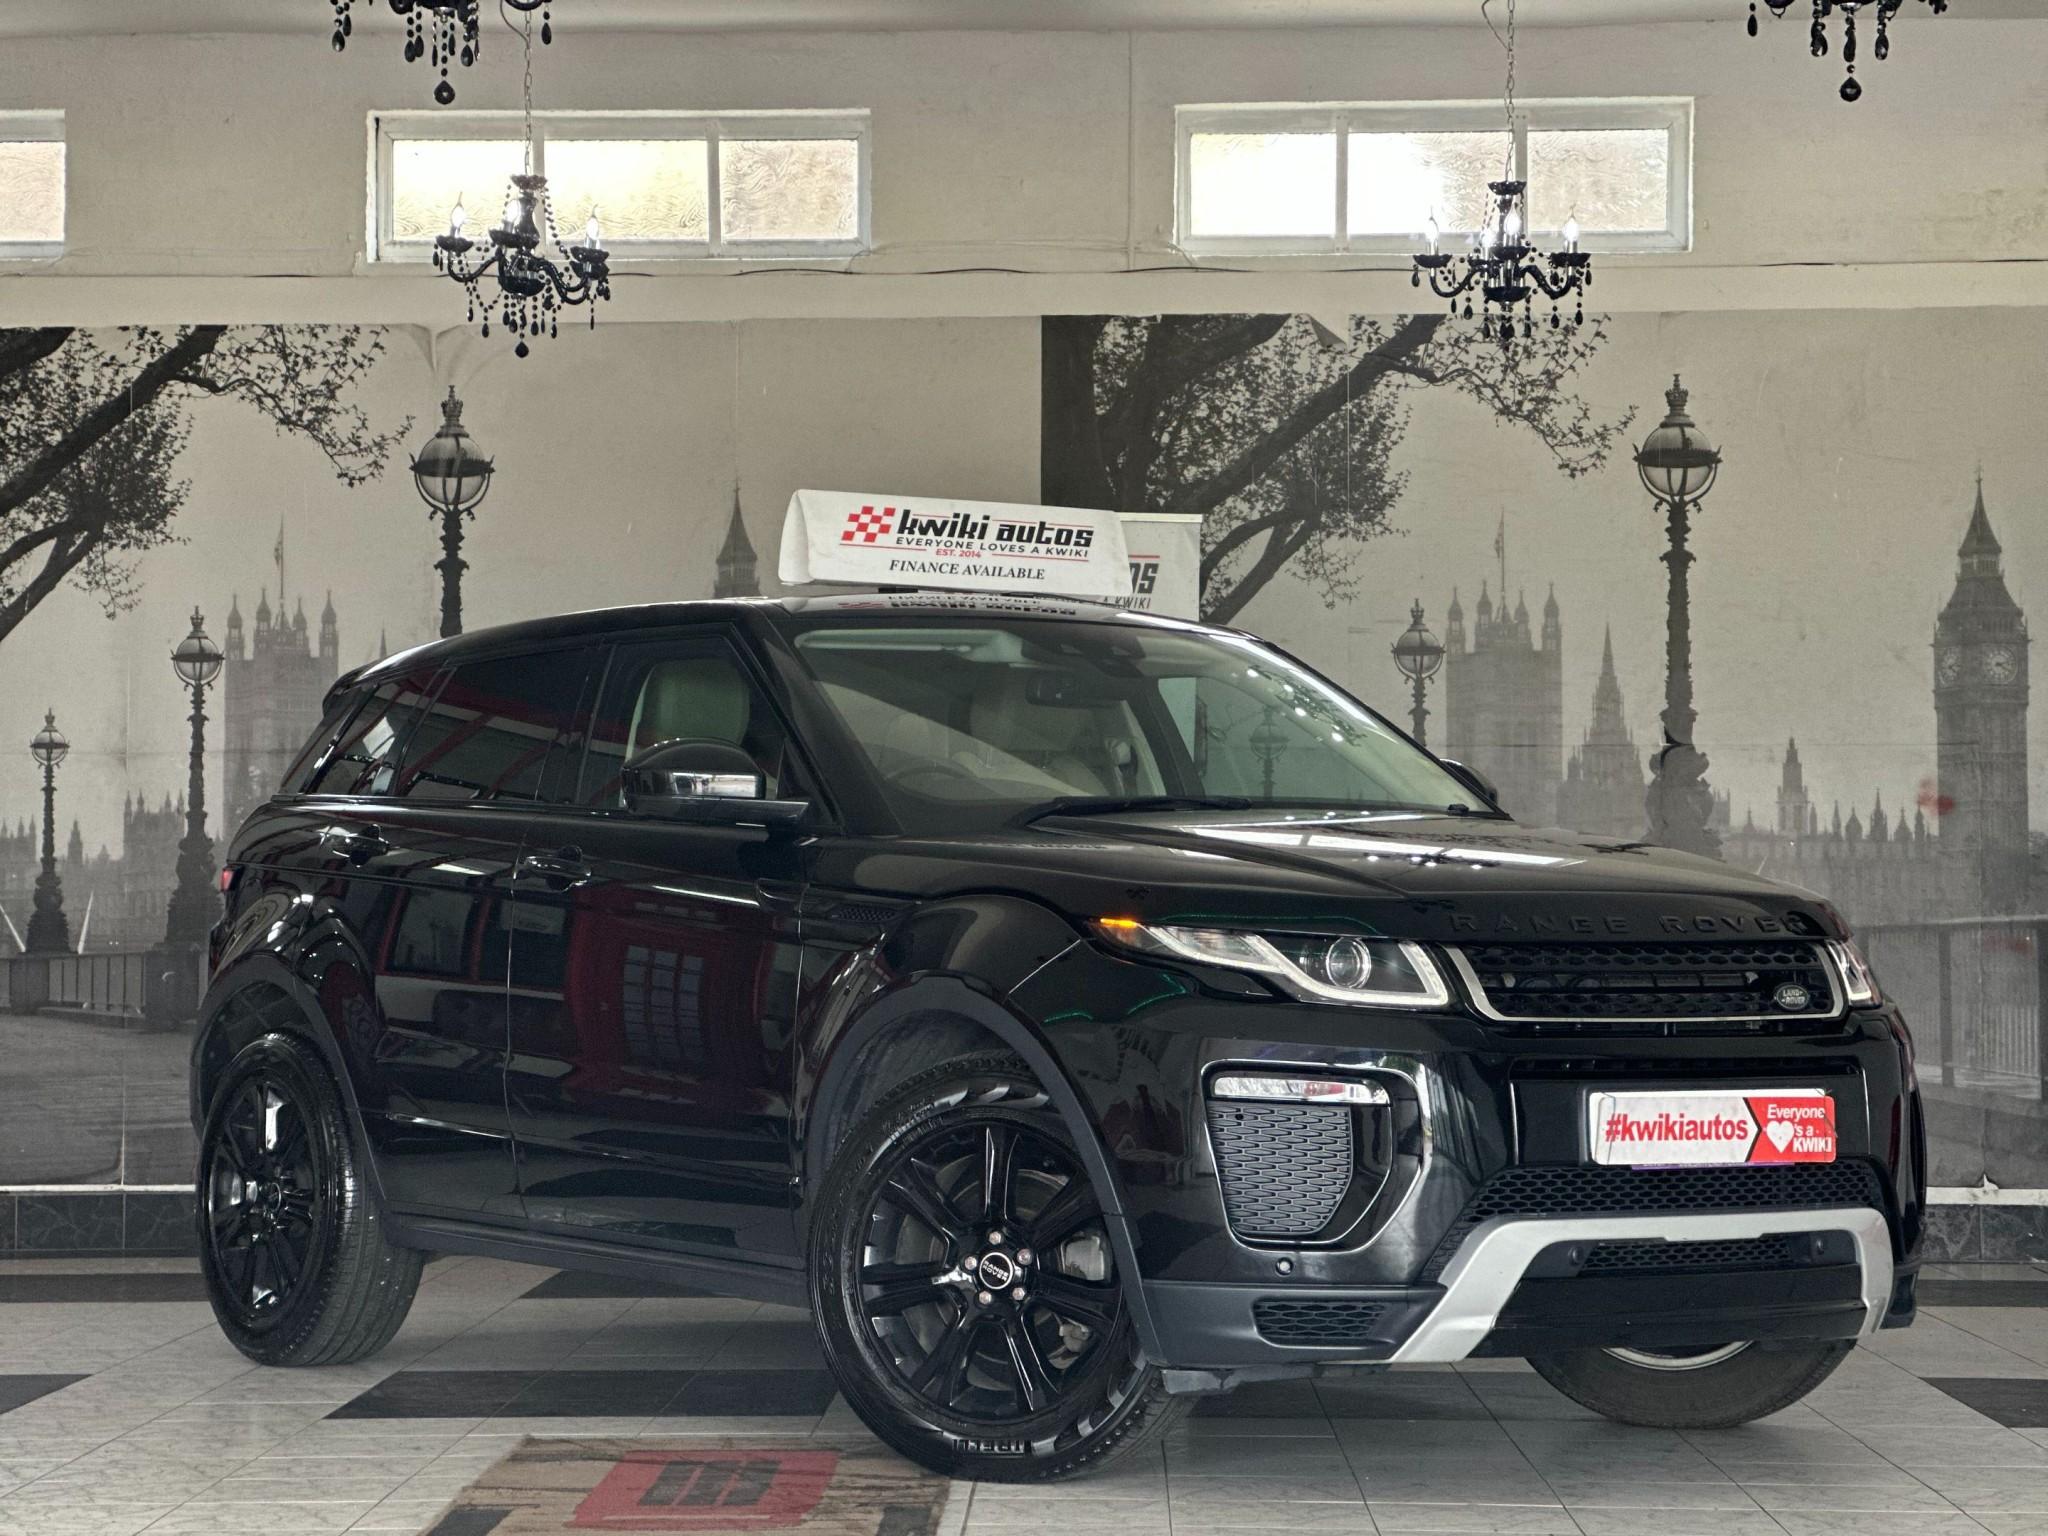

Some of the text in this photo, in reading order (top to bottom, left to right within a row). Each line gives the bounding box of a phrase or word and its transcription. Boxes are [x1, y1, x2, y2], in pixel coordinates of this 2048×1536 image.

[896, 509, 1094, 548] kwiki autos
[896, 536, 1089, 558] EVERYONE LOVES A KWIKI
[935, 549, 982, 558] EST. 2014
[889, 559, 1046, 580] FINANCE AVAILABLE
[1449, 913, 1807, 935] RANGE ROVER
[1767, 1103, 1825, 1121] Everyone
[1605, 1112, 1749, 1142] #kwikiautos
[1805, 1126, 1813, 1136] a
[1792, 1138, 1832, 1153] KWIKI
